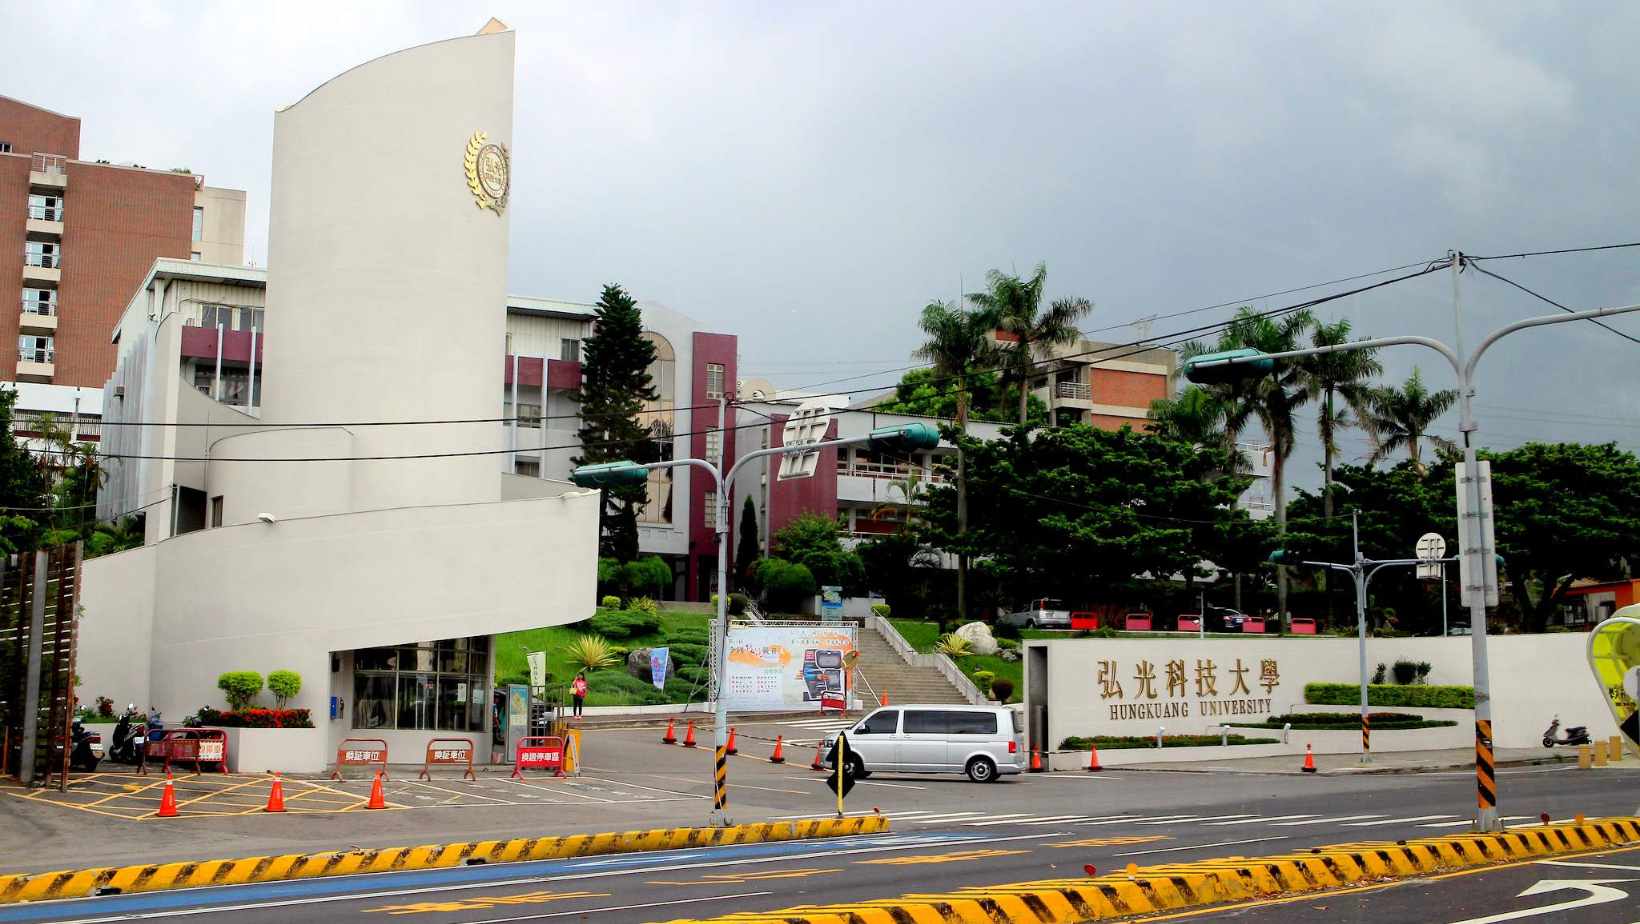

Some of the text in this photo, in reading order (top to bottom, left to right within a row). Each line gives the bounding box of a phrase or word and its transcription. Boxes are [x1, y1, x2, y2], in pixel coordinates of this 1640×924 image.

[1097, 657, 1280, 700] 弘光科技大學
[1110, 698, 1272, 721] HUNGKUANG UNIVERSITY
